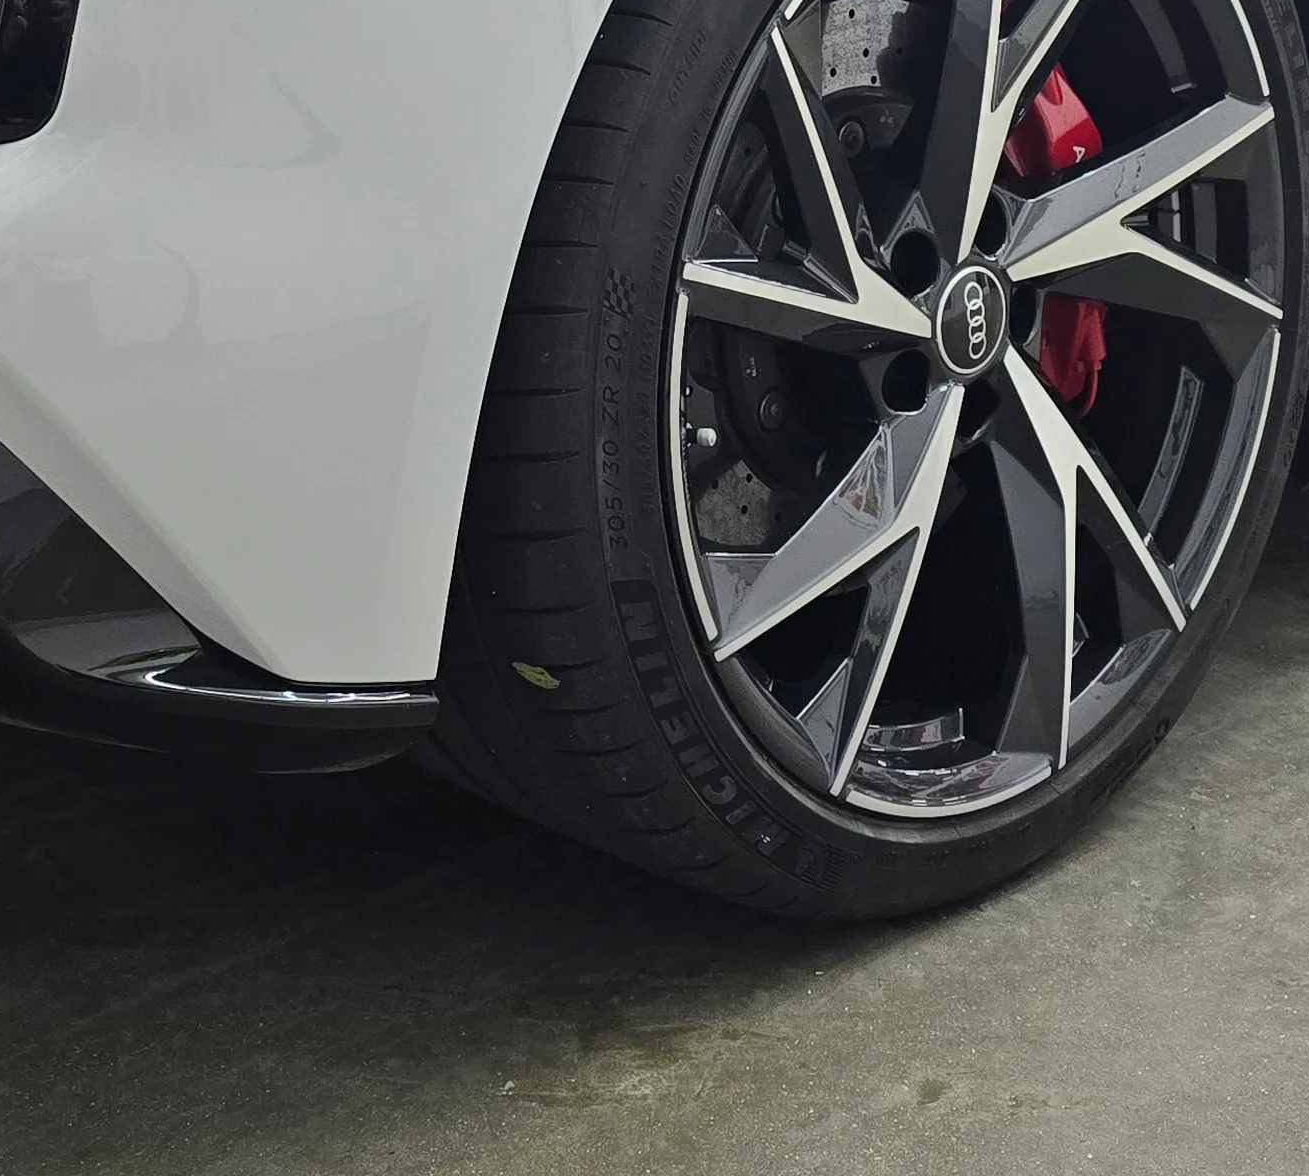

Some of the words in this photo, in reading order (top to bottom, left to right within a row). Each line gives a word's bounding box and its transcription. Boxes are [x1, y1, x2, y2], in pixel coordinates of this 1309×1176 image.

[603, 332, 624, 374] 20
[600, 384, 623, 427] ZR
[601, 438, 629, 550] 305/30
[620, 601, 794, 857] MICHELIN
